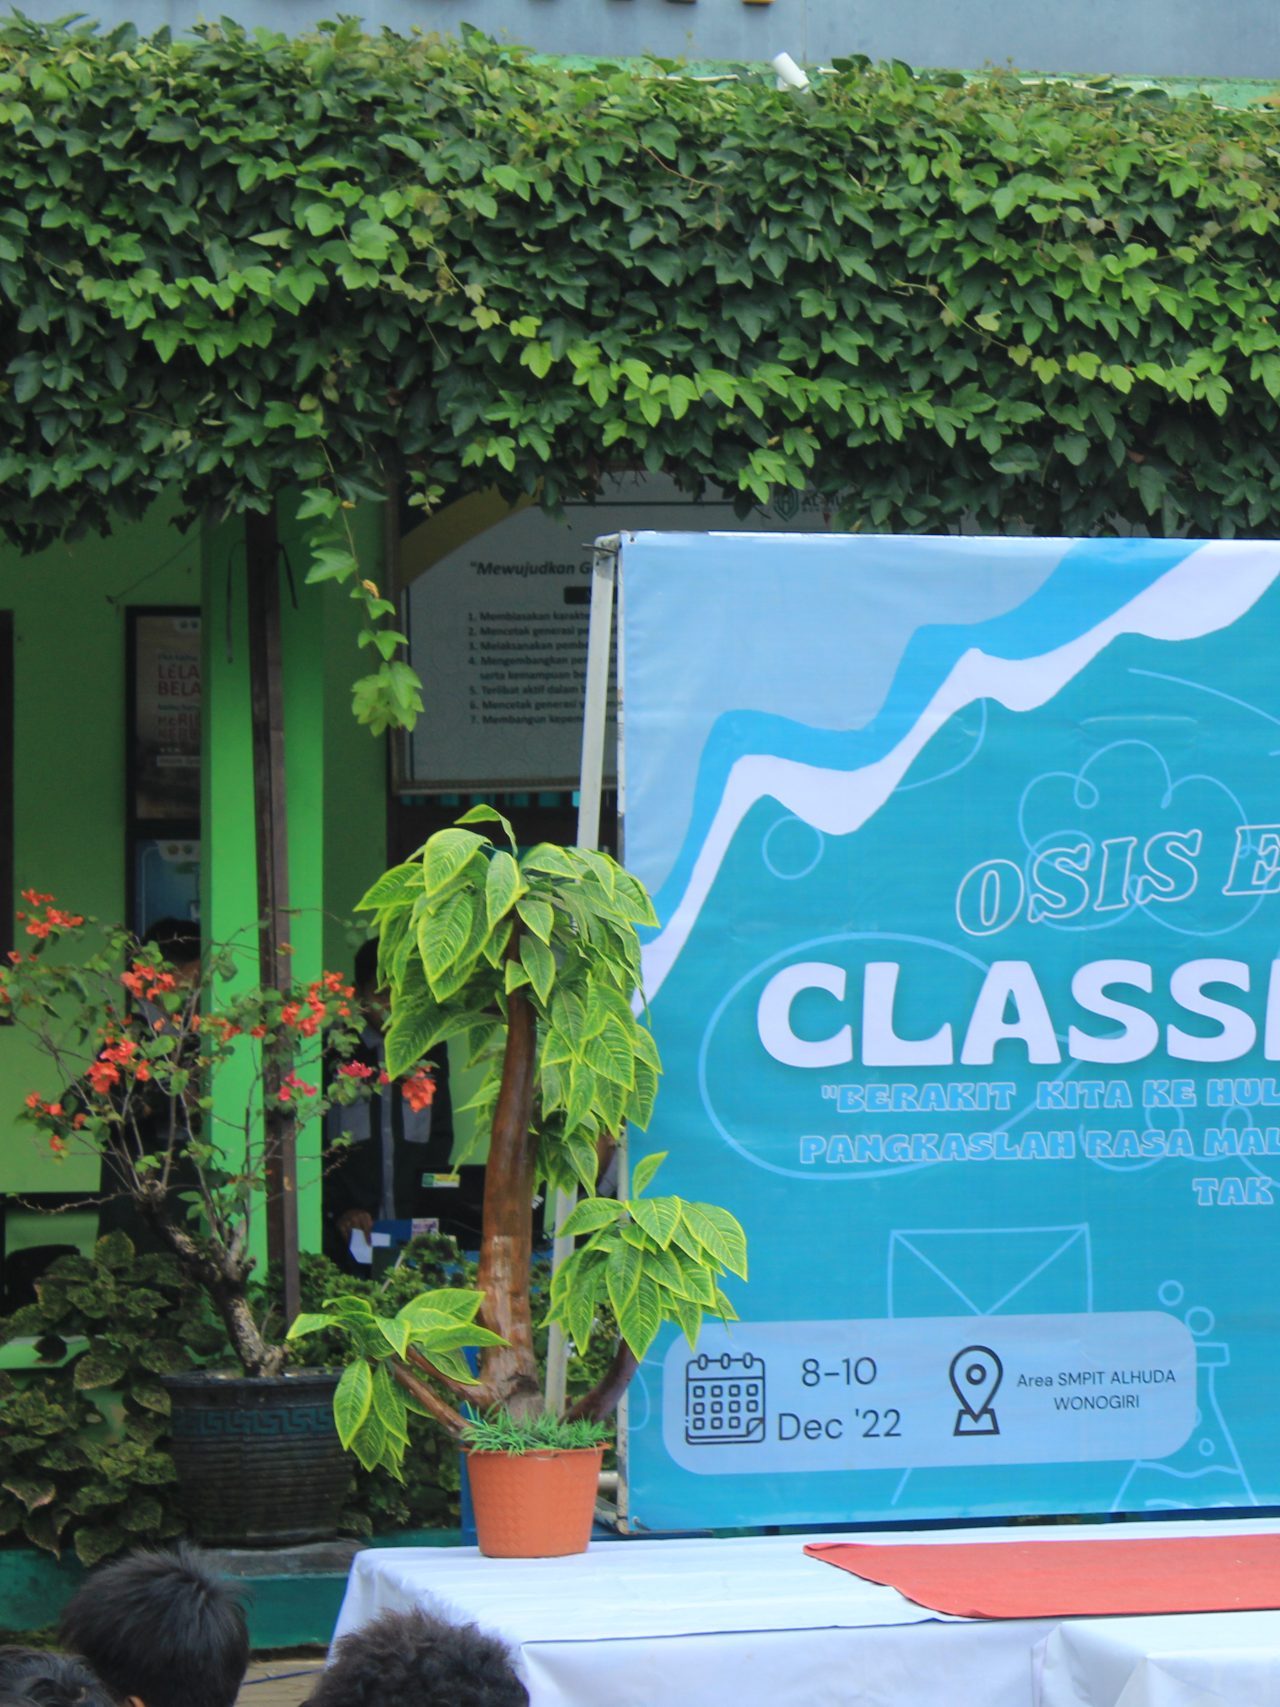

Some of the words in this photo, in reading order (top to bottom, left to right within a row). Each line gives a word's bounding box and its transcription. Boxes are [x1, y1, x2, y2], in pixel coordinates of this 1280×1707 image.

[956, 828, 1201, 937] OSIS
[821, 1081, 1017, 1113] "BERAKIT
[1036, 1080, 1133, 1110] KITA
[1142, 1078, 1198, 1108] KE
[799, 1131, 1076, 1164] PANGKASLAH
[1085, 1129, 1194, 1158] RASA
[1192, 1177, 1274, 1205] TAK
[802, 1357, 877, 1387] 8-10
[1017, 1374, 1053, 1387] Area
[1058, 1371, 1105, 1386] SMPIT
[1110, 1369, 1176, 1384] ALHUDA
[1054, 1395, 1140, 1410] WONOGIRI
[778, 1412, 843, 1441] Dec
[855, 1408, 902, 1438] '22
